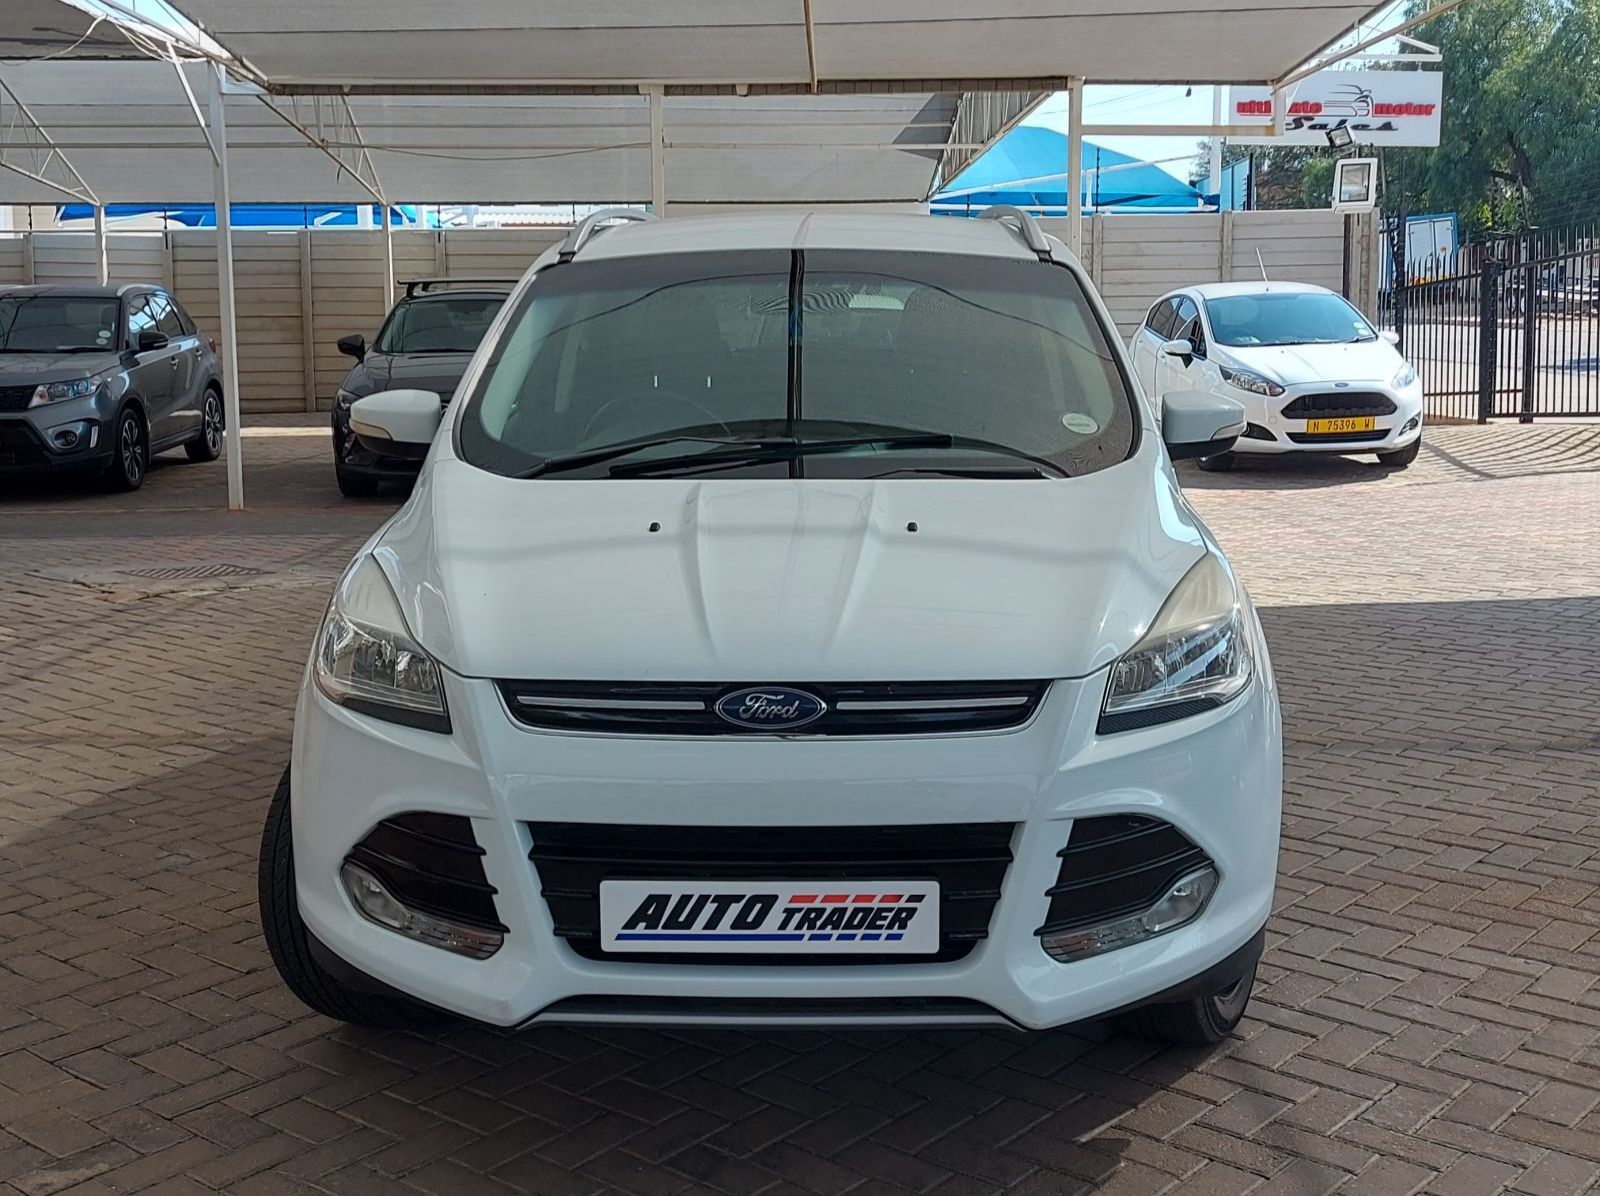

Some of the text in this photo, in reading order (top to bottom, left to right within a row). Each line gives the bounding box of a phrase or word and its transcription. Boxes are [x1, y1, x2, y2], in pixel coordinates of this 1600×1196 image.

[1374, 101, 1436, 116] motor
[1313, 418, 1371, 432] N 75396 W
[739, 692, 800, 719] Ford
[621, 893, 919, 931] AUTO TRADER
